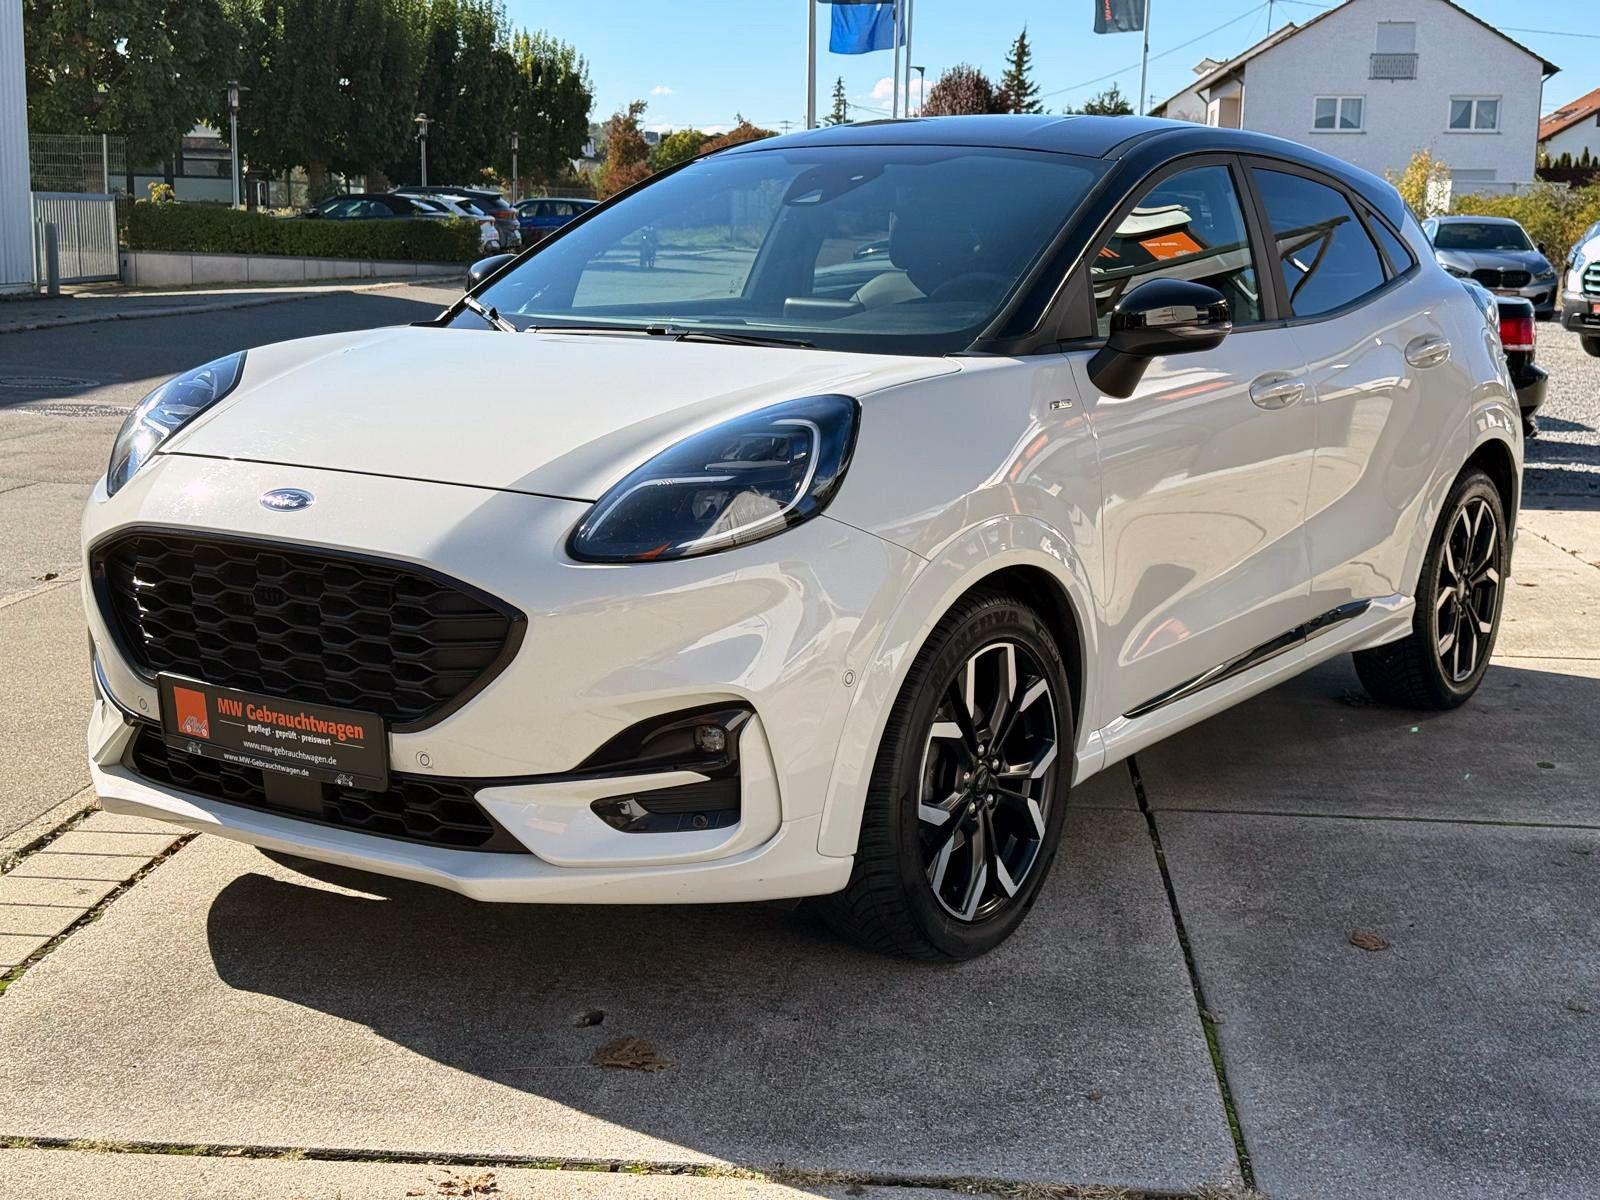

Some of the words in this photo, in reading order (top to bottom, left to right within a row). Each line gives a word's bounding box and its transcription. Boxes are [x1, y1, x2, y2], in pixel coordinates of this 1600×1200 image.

[217, 698, 242, 717] MW
[246, 704, 364, 741] Gebrauchtwagen
[247, 724, 271, 736] gepflegt
[275, 730, 297, 740] geprüft
[301, 735, 331, 746] preiswert
[243, 740, 337, 765] www.mw-gebrauchtwagen.de
[223, 753, 310, 777] www.MW-Gebrauchtwagen.de
